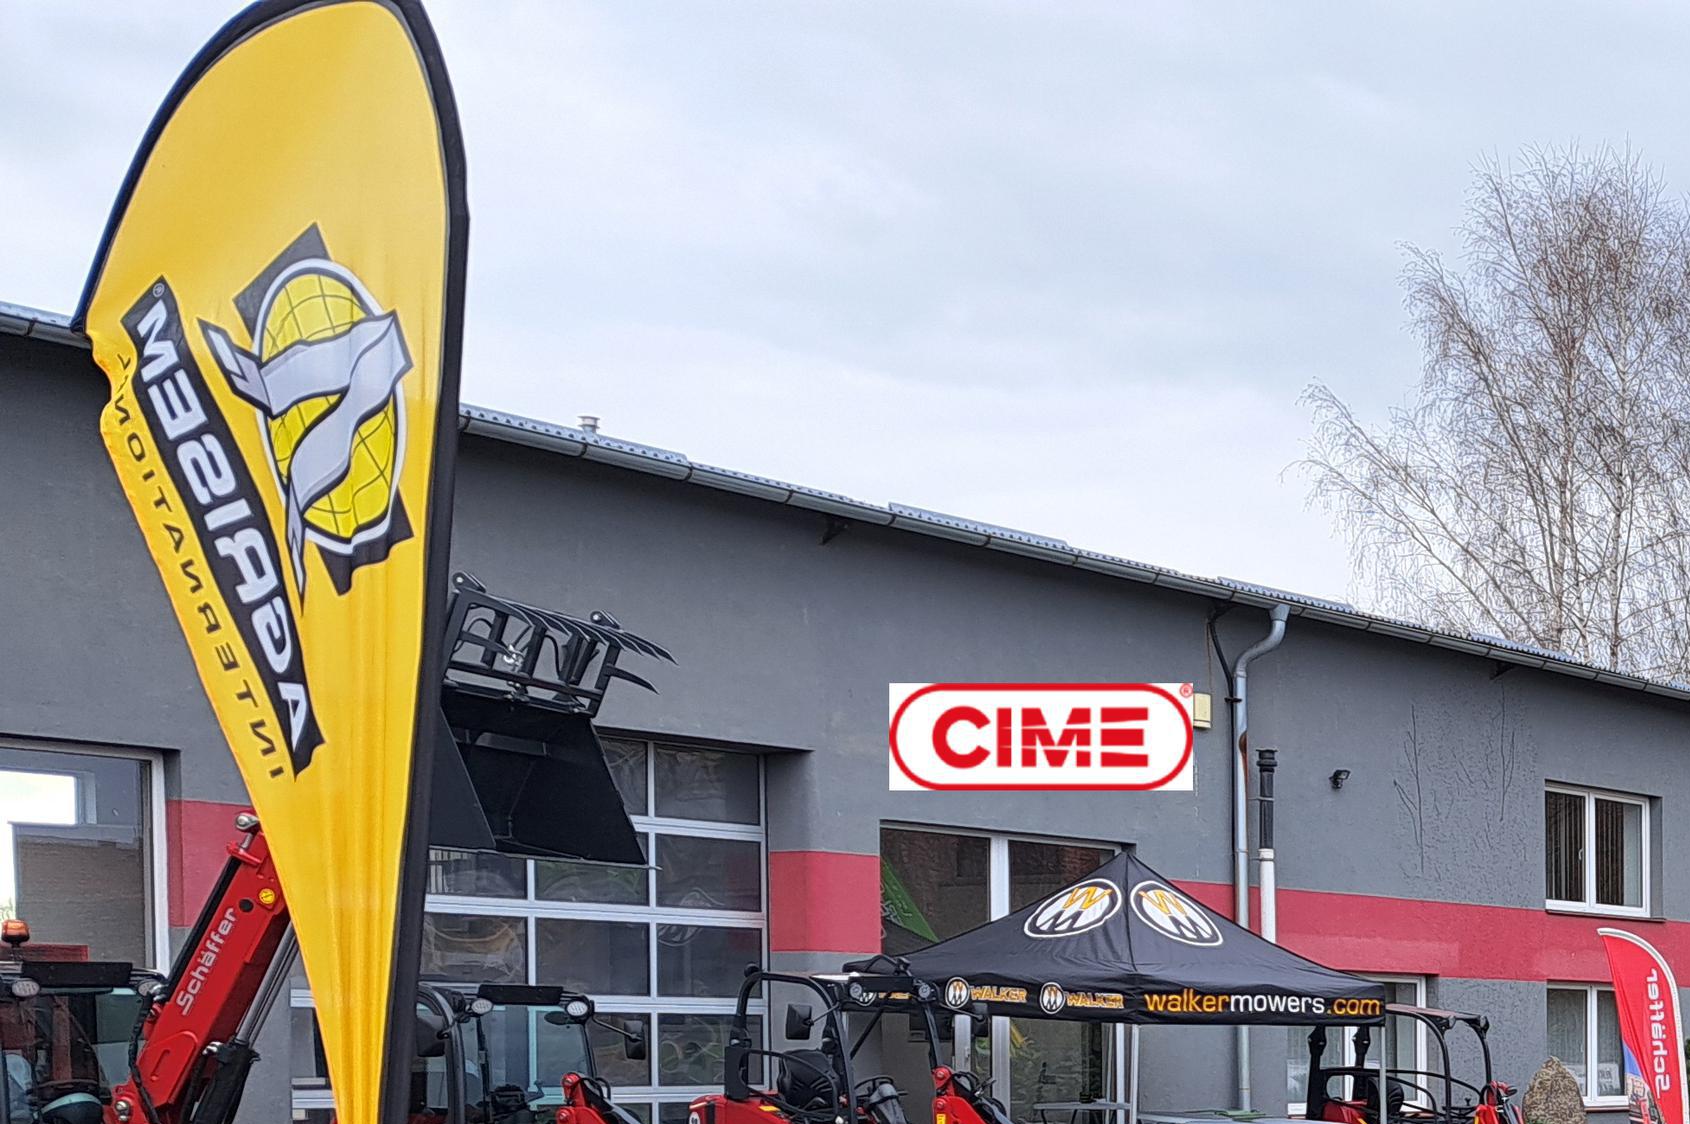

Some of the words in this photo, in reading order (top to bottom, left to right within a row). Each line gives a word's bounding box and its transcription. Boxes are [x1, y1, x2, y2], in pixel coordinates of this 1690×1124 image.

[176, 907, 236, 1016] Schäffer
[970, 986, 1028, 1003] WALKER
[1065, 991, 1125, 1009] WALKER
[1143, 987, 1381, 1016] walkermowers.com
